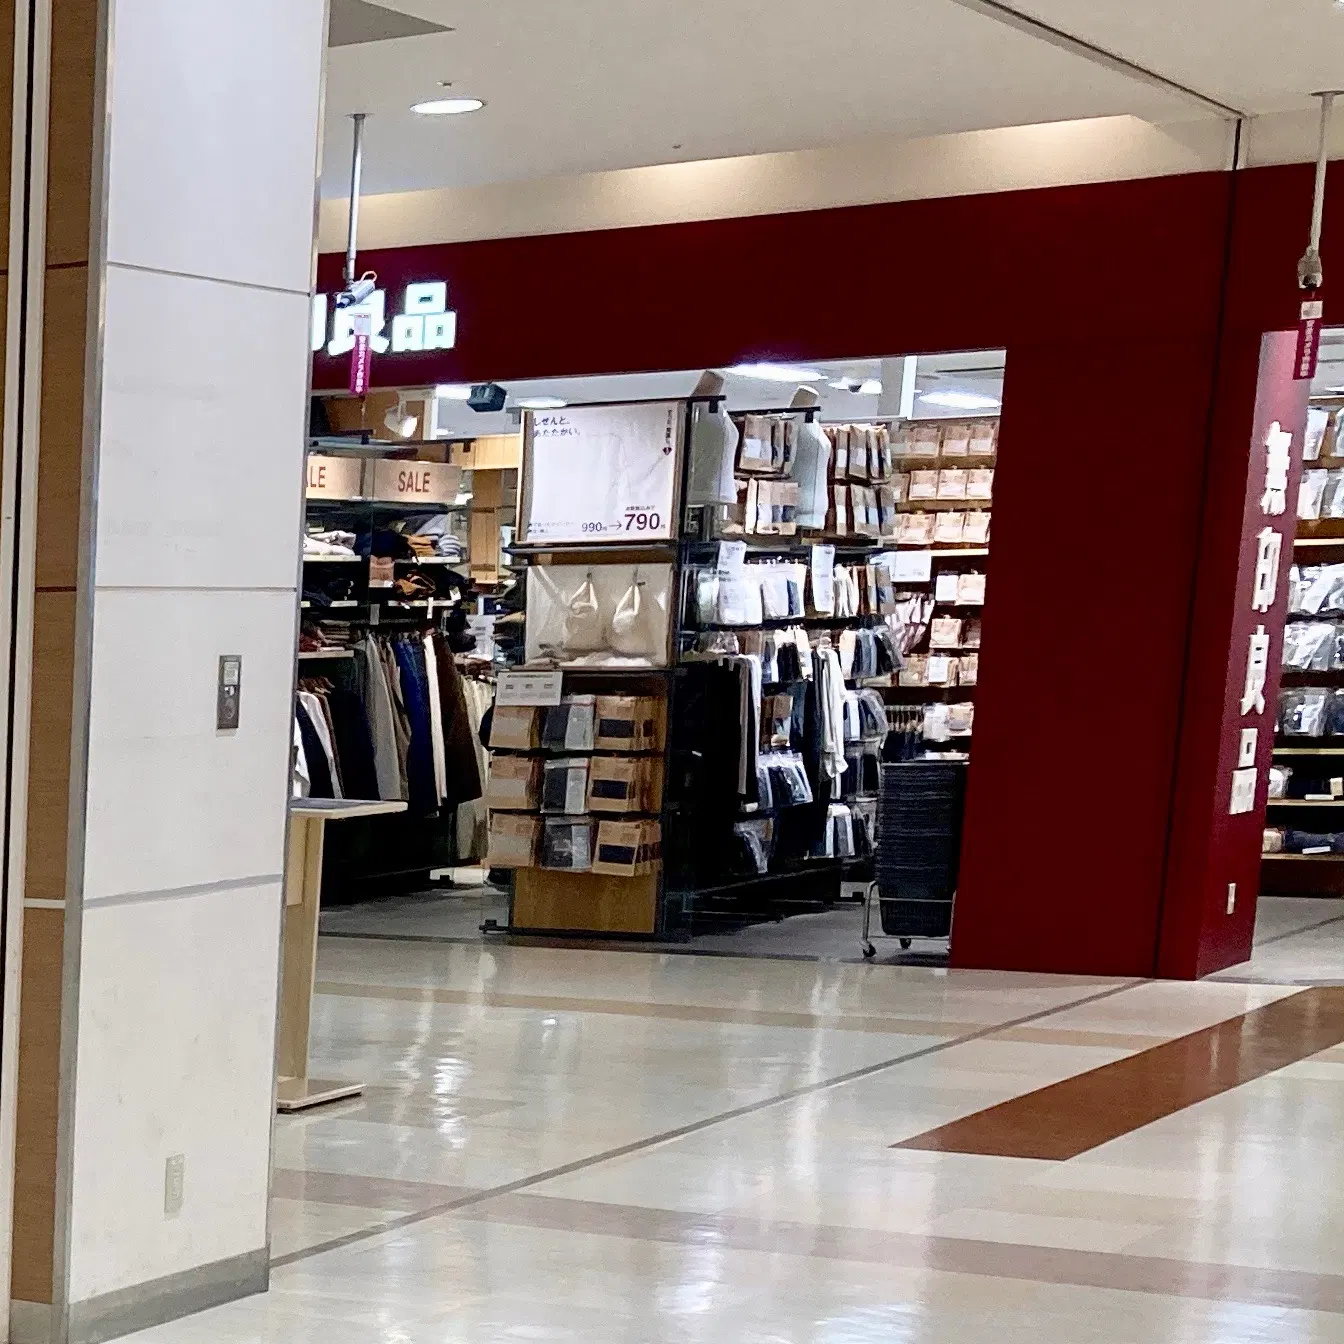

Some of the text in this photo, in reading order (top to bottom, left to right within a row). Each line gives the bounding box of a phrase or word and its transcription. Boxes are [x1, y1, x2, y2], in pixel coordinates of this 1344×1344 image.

[307, 466, 326, 488] LE
[398, 471, 431, 493] SALE
[1229, 421, 1292, 815] 無印良品
